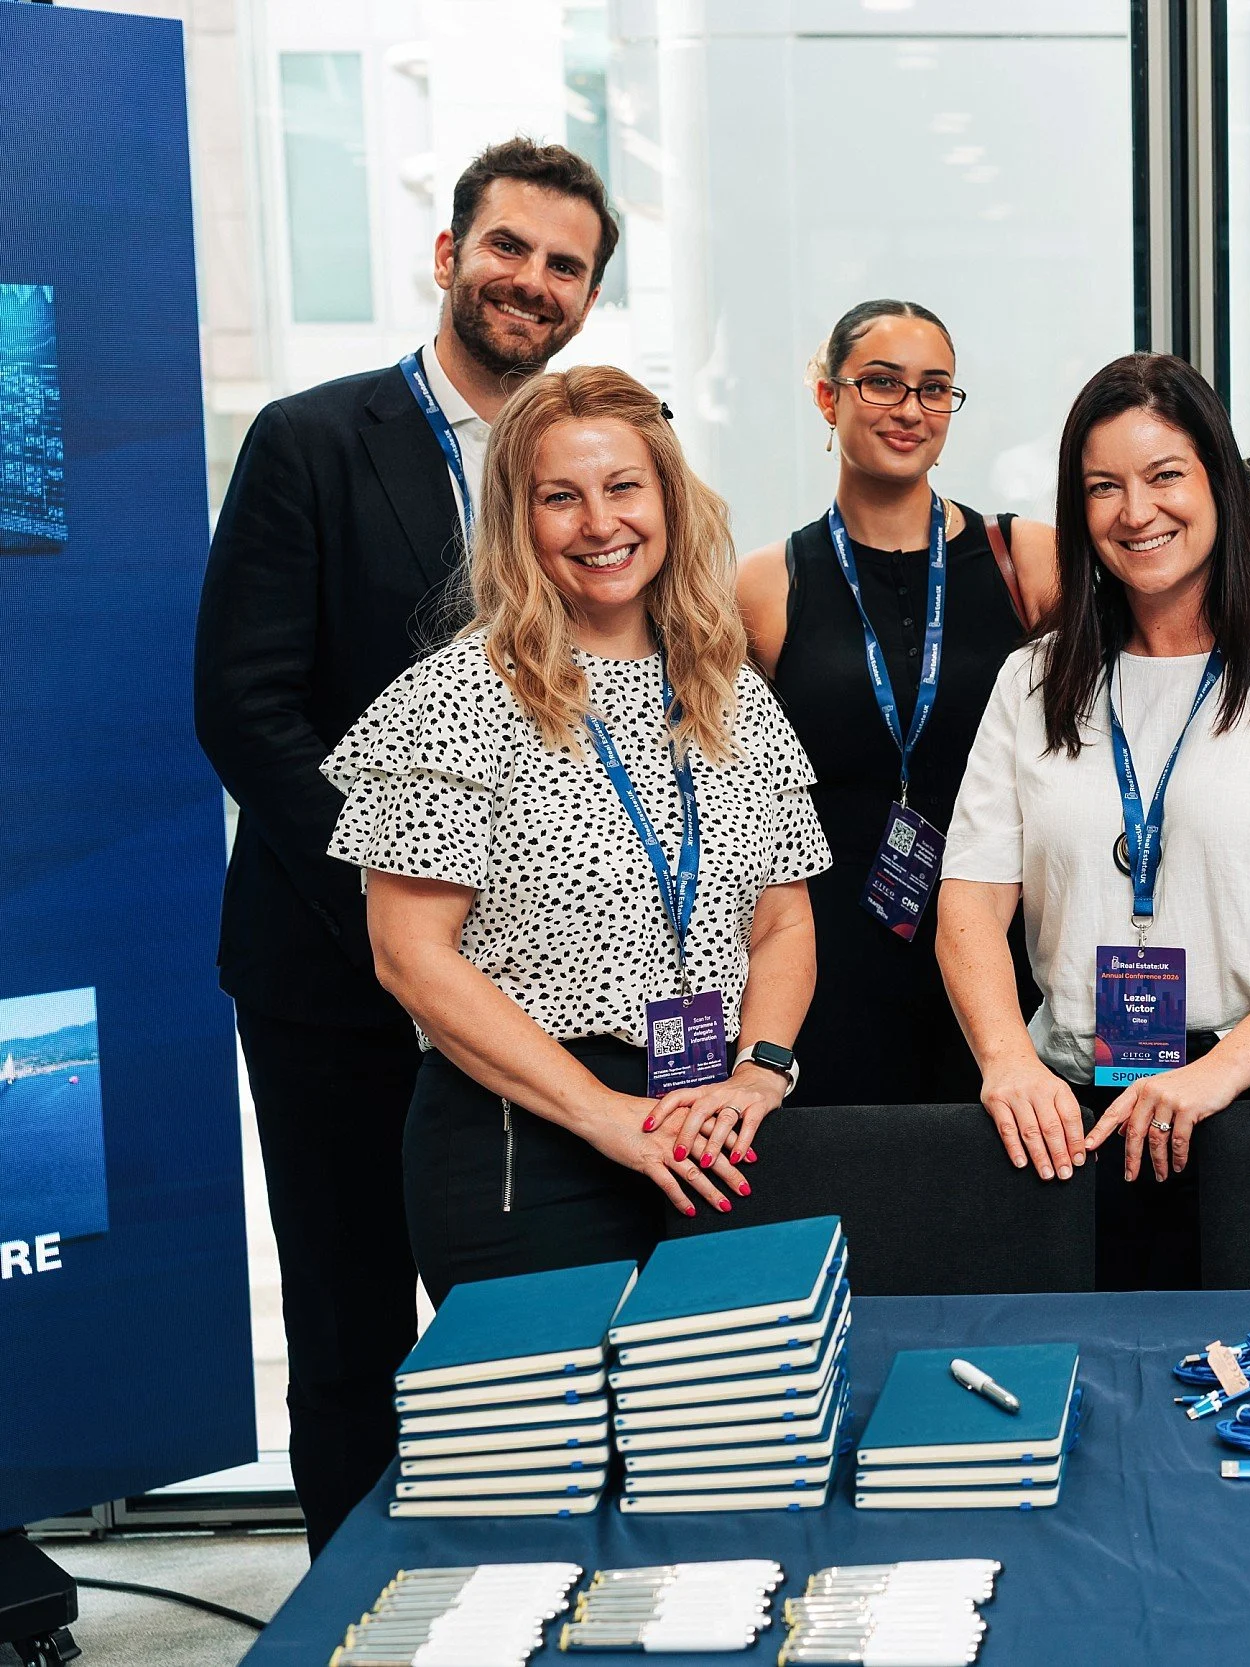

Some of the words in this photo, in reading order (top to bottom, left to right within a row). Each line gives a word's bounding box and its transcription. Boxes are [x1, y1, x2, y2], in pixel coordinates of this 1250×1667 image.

[590, 716, 608, 745] Estate:U
[1123, 748, 1132, 778] Estate:UK
[1140, 850, 1149, 884] Estate:UK
[902, 896, 919, 913] CMS
[1136, 962, 1169, 970] Estate:UK
[1125, 1004, 1155, 1013] Victor
[1158, 1050, 1180, 1059] CMS
[0, 1231, 62, 1279] RE
